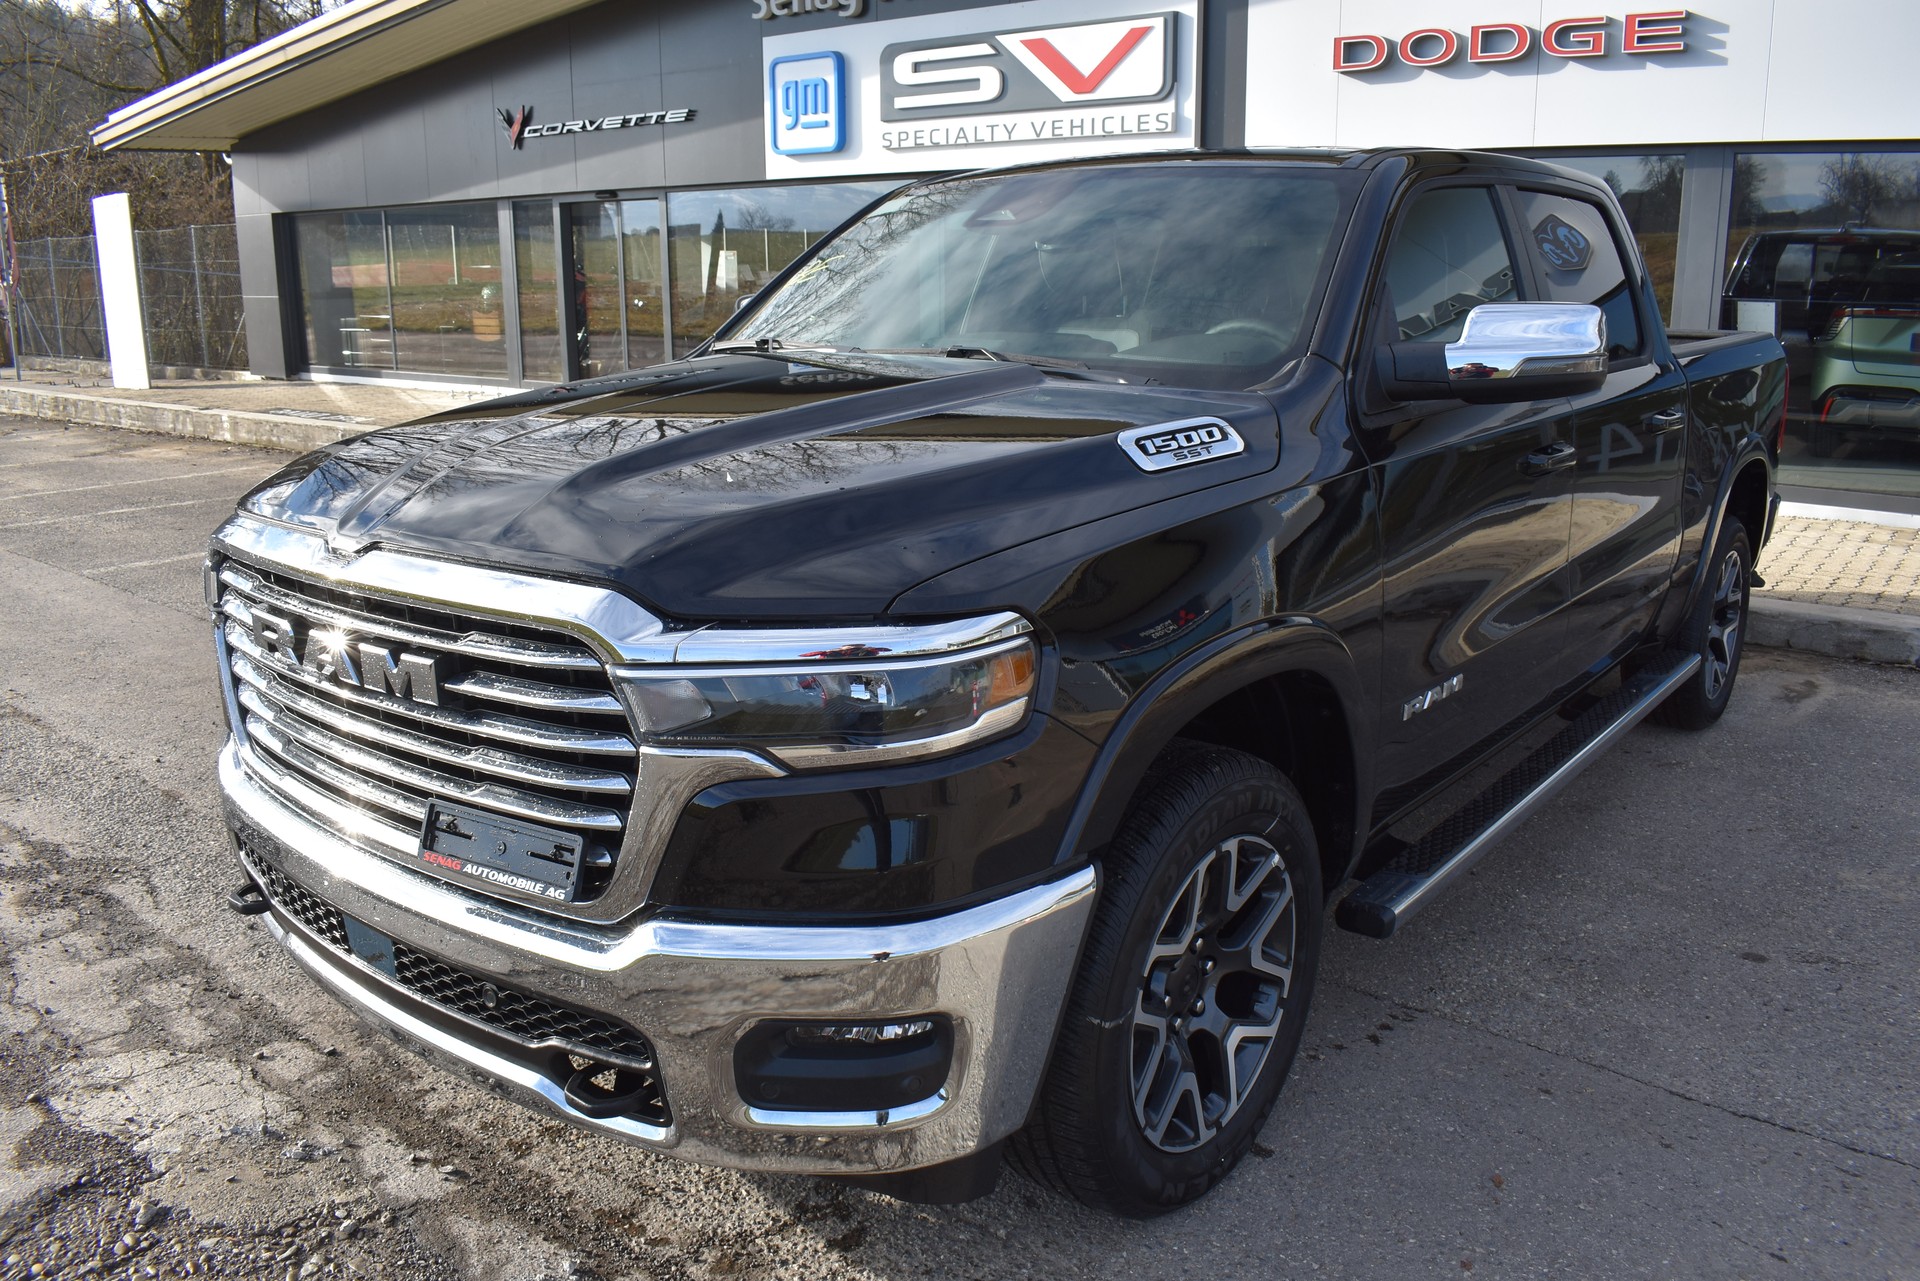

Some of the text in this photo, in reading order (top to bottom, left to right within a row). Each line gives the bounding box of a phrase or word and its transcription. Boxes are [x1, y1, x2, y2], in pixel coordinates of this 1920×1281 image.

[893, 22, 1159, 109] SV
[1332, 10, 1687, 72] DODGE
[523, 108, 689, 138] CORVETTE
[781, 77, 829, 131] gm
[881, 112, 1169, 148] SPECIALTY VEHICLES
[1139, 427, 1222, 455] 1500
[1172, 446, 1214, 461] SST
[250, 608, 439, 706] RAM
[1403, 672, 1464, 721] RAM
[423, 851, 565, 901] SENAG AUTOMOBILE AG
